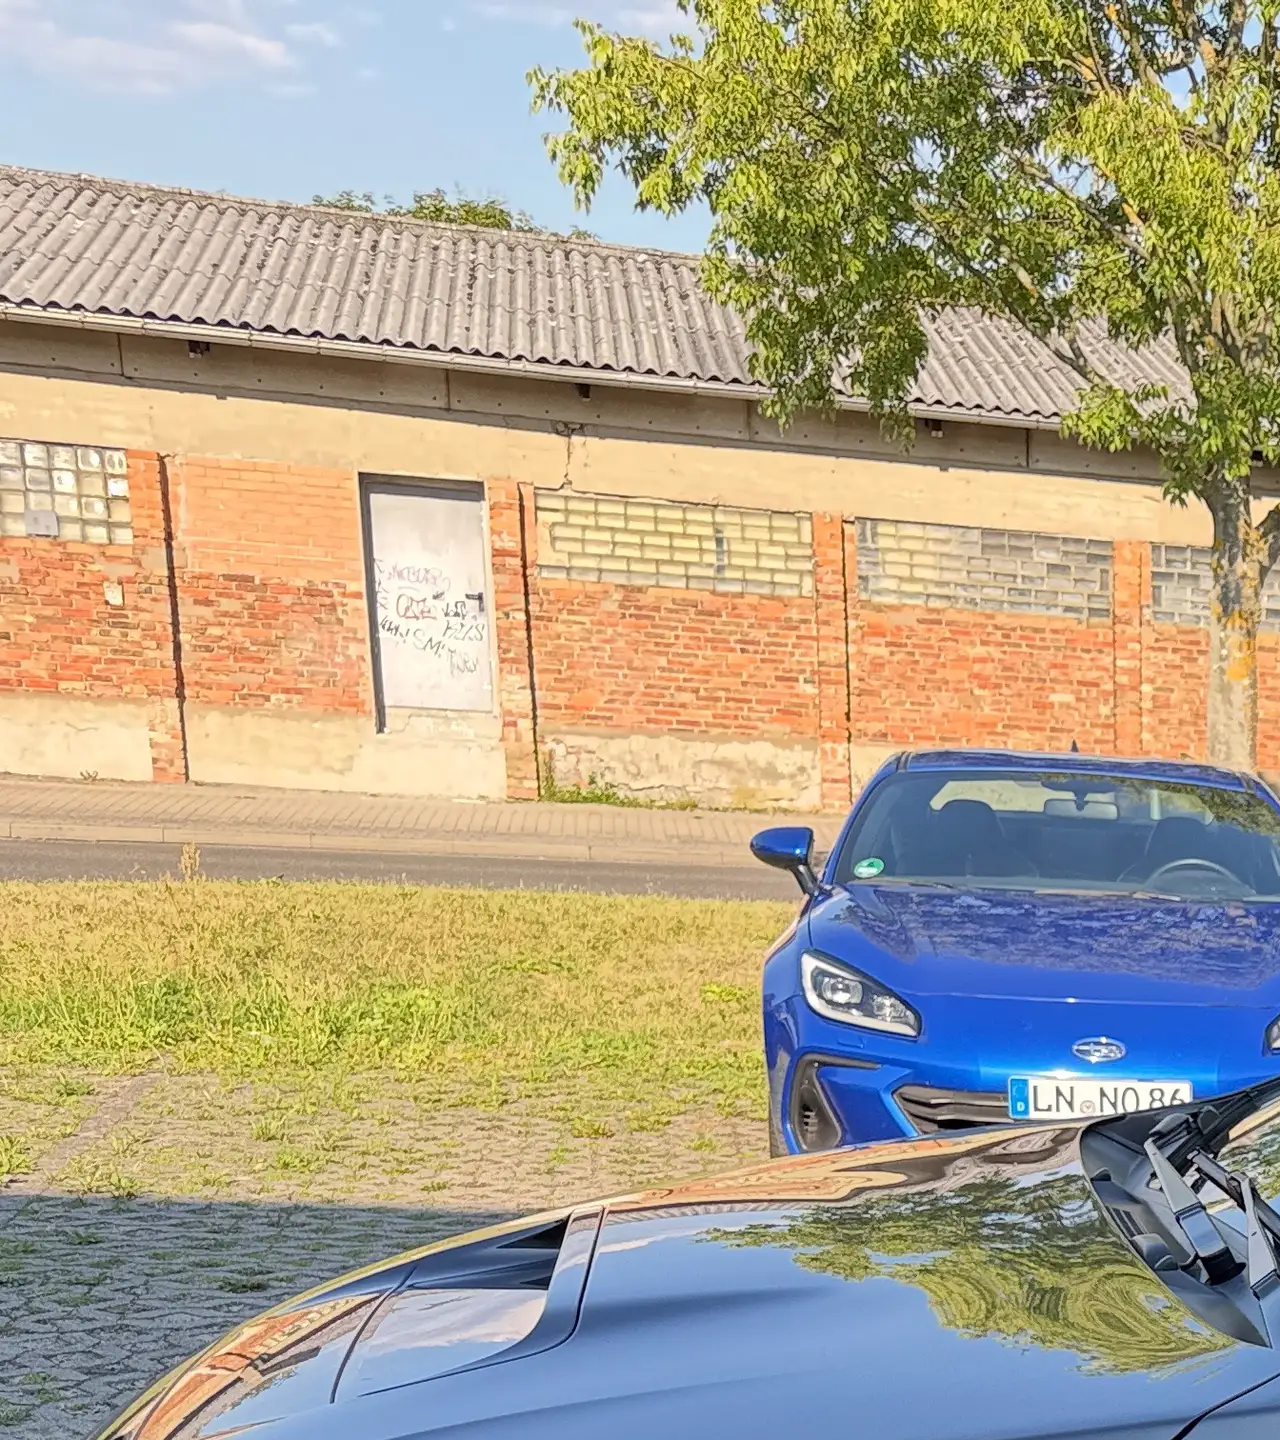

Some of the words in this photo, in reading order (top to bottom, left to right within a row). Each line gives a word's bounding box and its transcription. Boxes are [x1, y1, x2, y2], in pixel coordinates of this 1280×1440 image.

[1016, 1101, 1025, 1112] D
[1033, 1085, 1075, 1113] LN
[1099, 1086, 1140, 1114] NO
